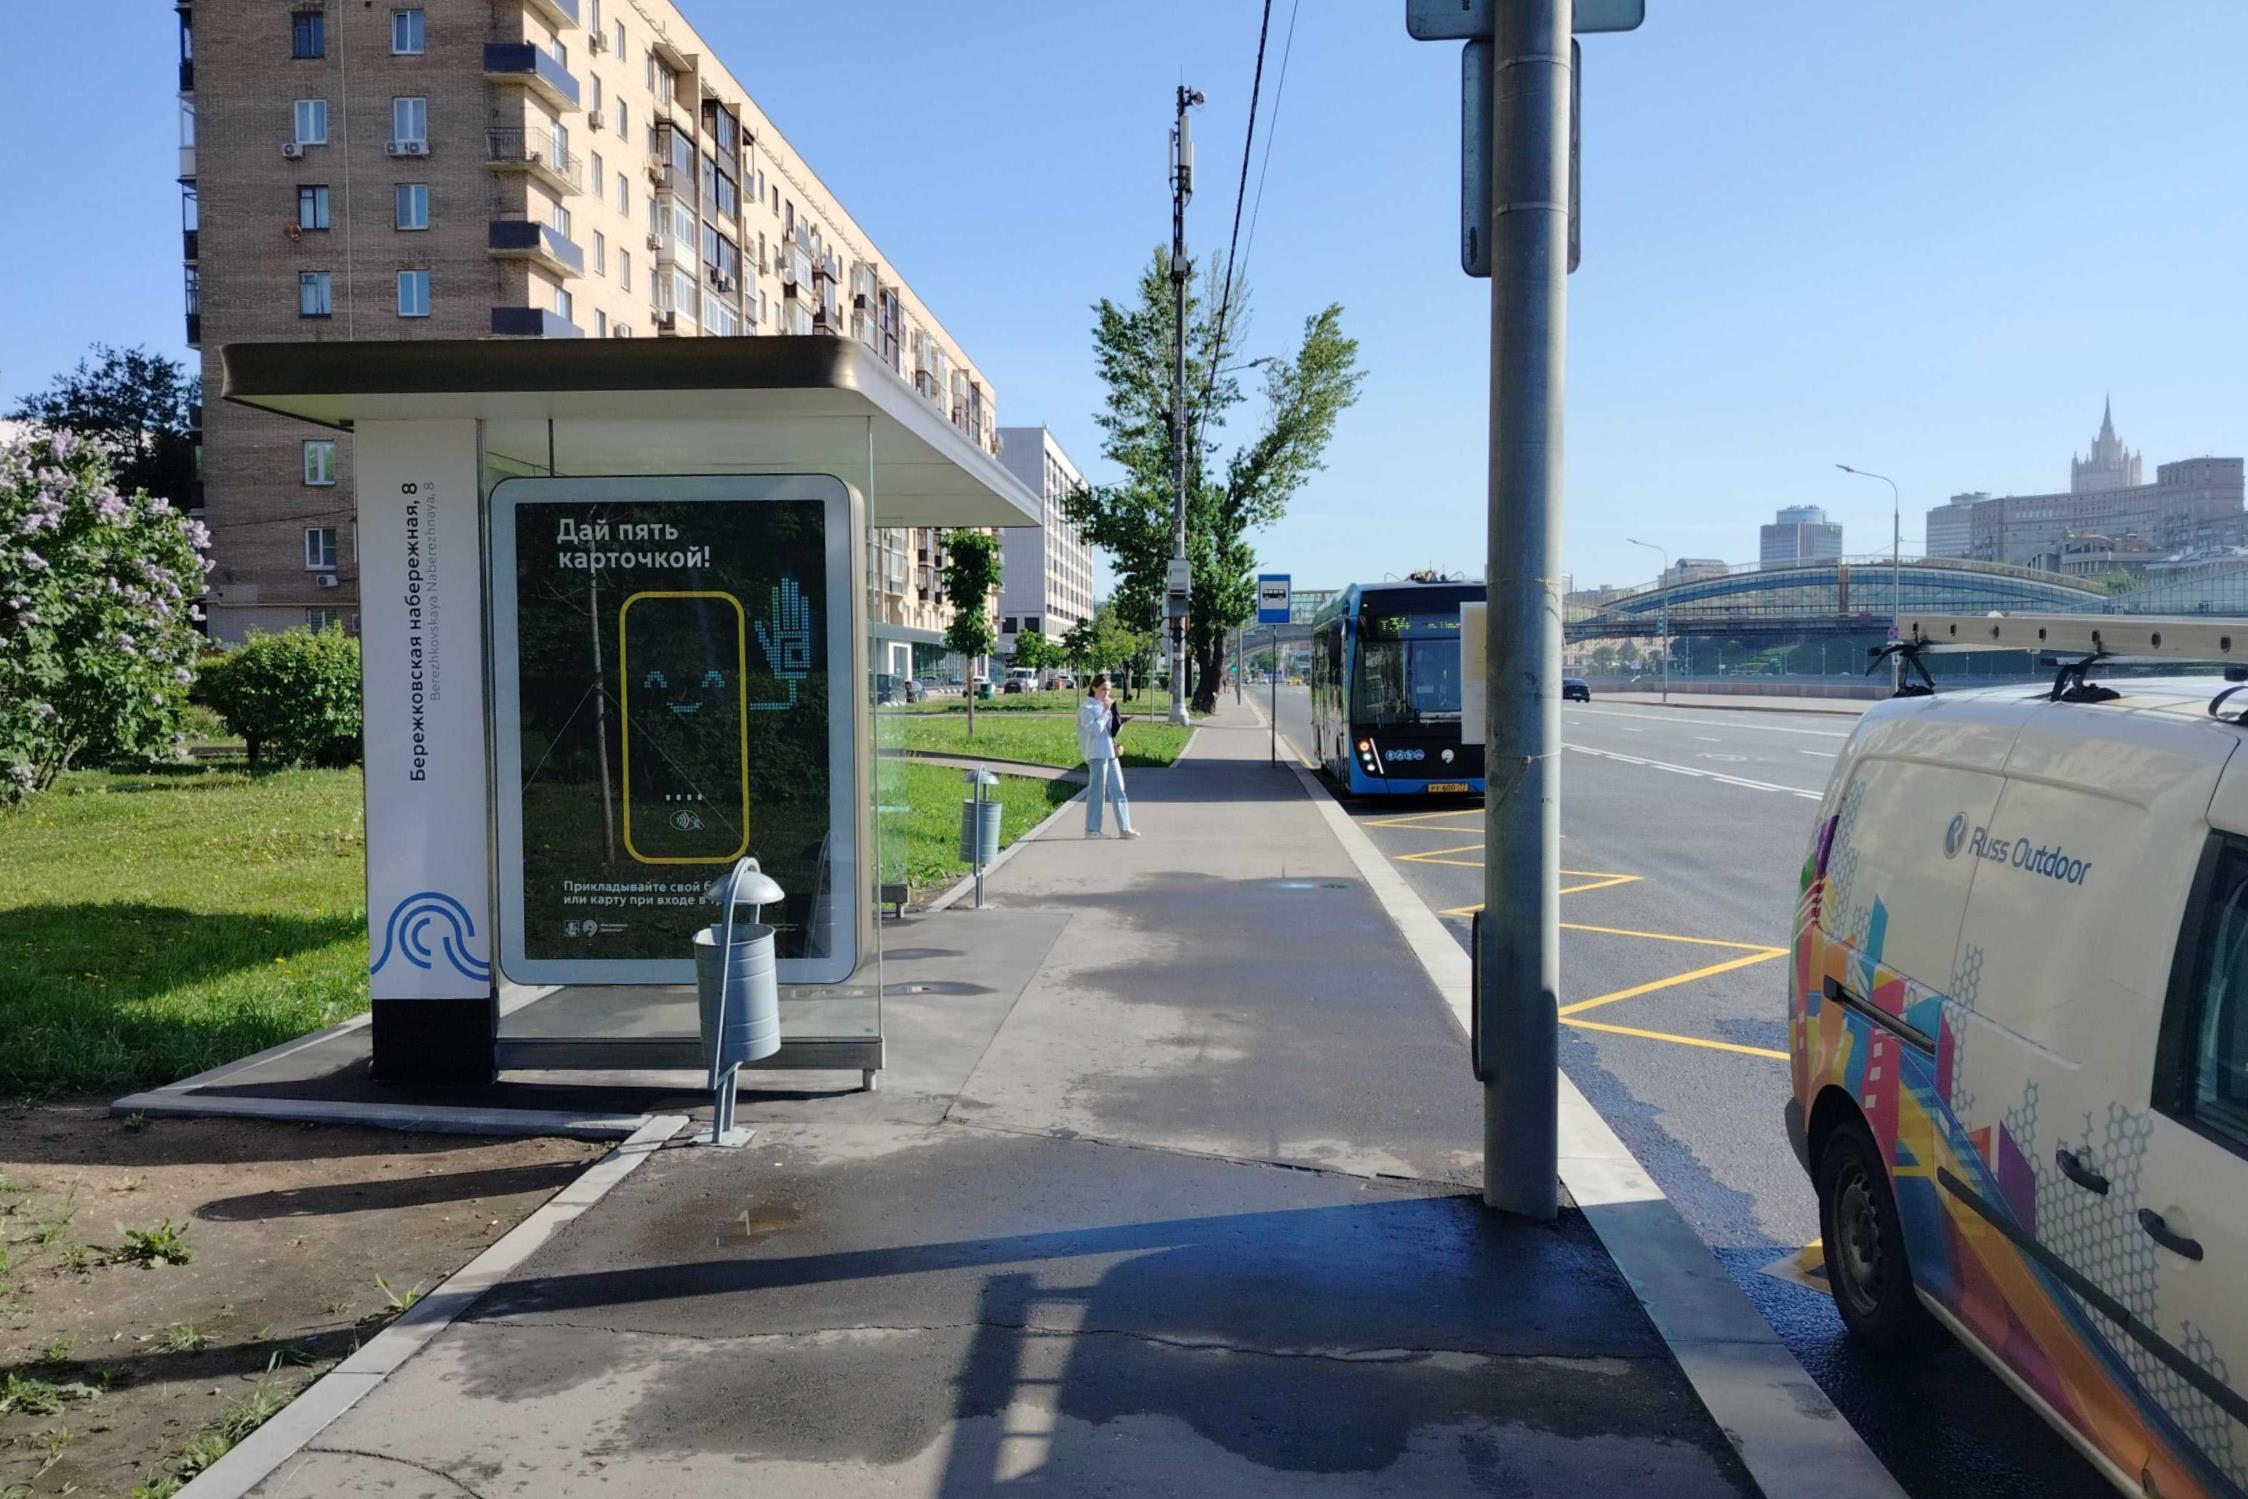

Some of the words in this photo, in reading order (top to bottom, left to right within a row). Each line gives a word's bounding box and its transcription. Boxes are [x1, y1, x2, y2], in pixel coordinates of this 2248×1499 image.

[401, 482, 418, 495] 8
[423, 481, 435, 491] 8
[425, 494, 438, 592] Naberezhnaya,
[556, 518, 610, 545] Дай
[618, 523, 679, 541] пять
[404, 499, 424, 630] набережная,
[558, 545, 711, 574] карточкой!
[427, 596, 441, 701] Berezhkovskaya
[409, 636, 429, 781] Бережковская
[1968, 826, 2010, 863] Russ
[2012, 837, 2092, 886] Outdoor
[563, 880, 667, 894] Прикладывайте
[670, 881, 701, 893] свой
[563, 896, 587, 905] или
[590, 896, 624, 908] карту
[629, 896, 654, 907] при
[656, 895, 694, 906] входе
[699, 896, 706, 905] в
